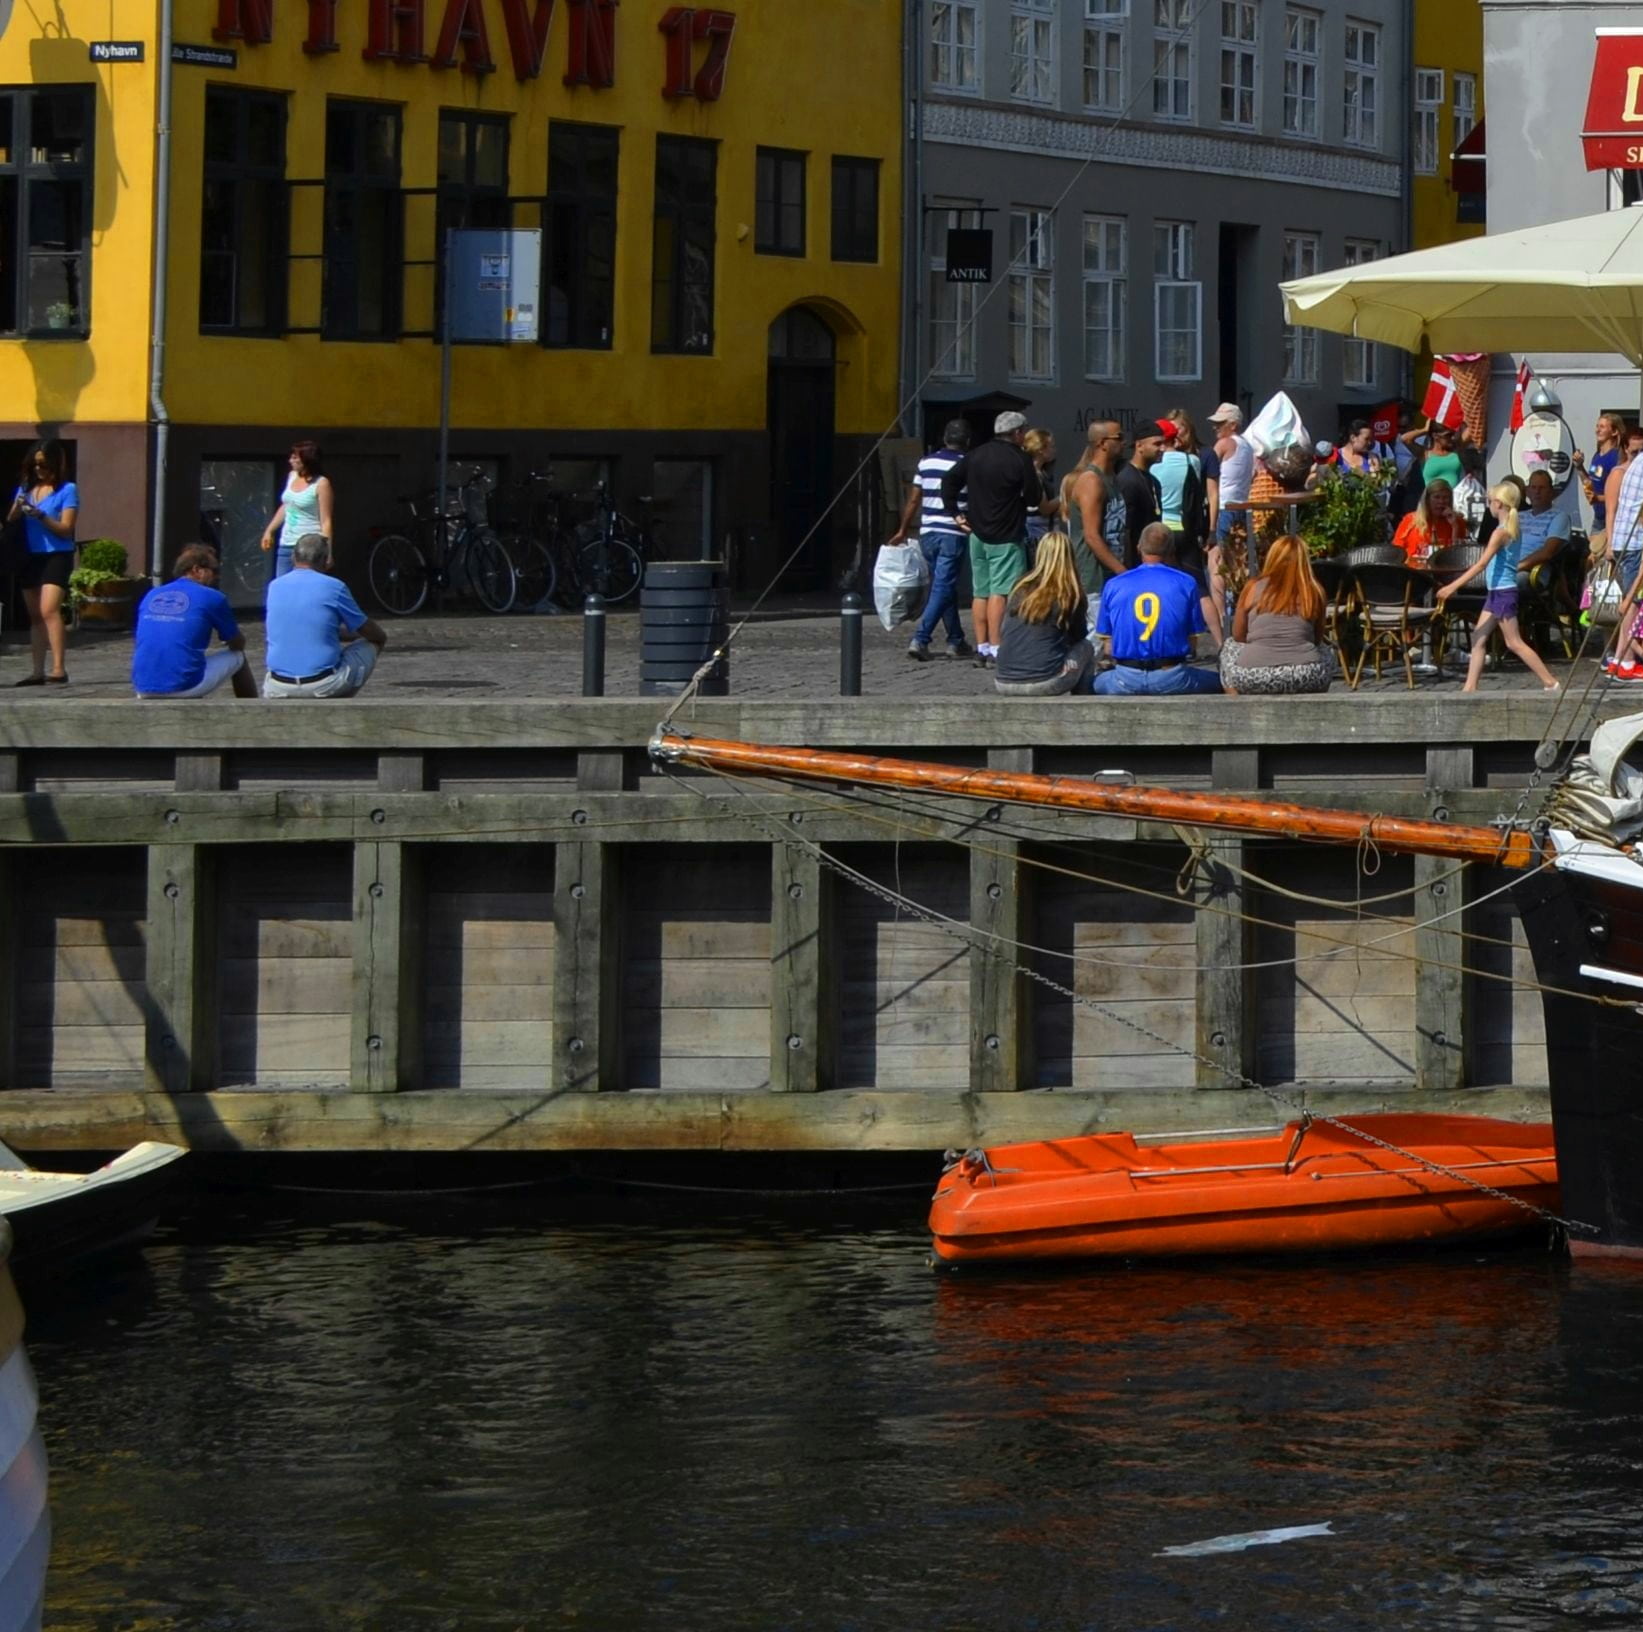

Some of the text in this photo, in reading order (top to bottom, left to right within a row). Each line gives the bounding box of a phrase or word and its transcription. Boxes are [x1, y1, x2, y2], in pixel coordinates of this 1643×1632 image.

[95, 44, 138, 60] Nyhavn
[656, 5, 738, 103] 17
[949, 268, 988, 280] ANTIK
[1133, 591, 1160, 643] 9
